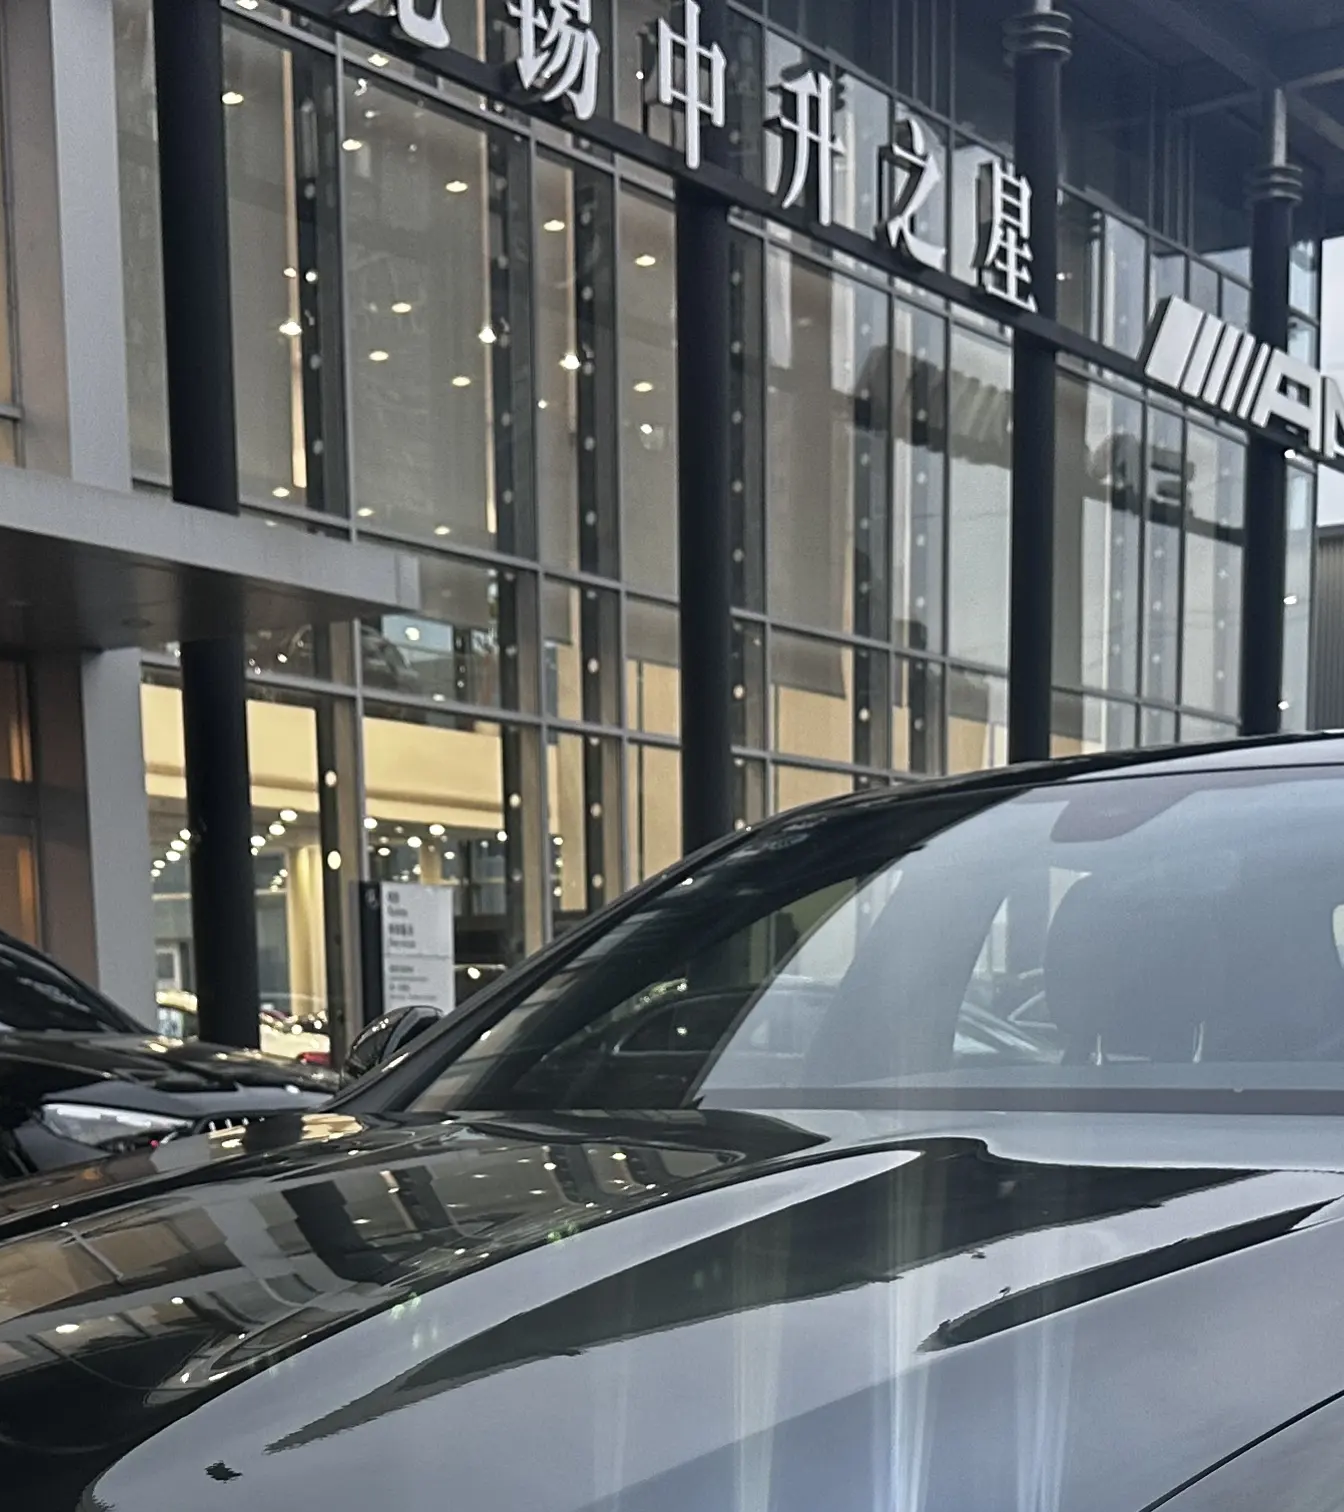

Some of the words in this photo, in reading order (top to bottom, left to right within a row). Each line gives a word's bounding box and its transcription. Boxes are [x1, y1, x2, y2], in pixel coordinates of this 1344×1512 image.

[347, 0, 1037, 312] 锡中升之星
